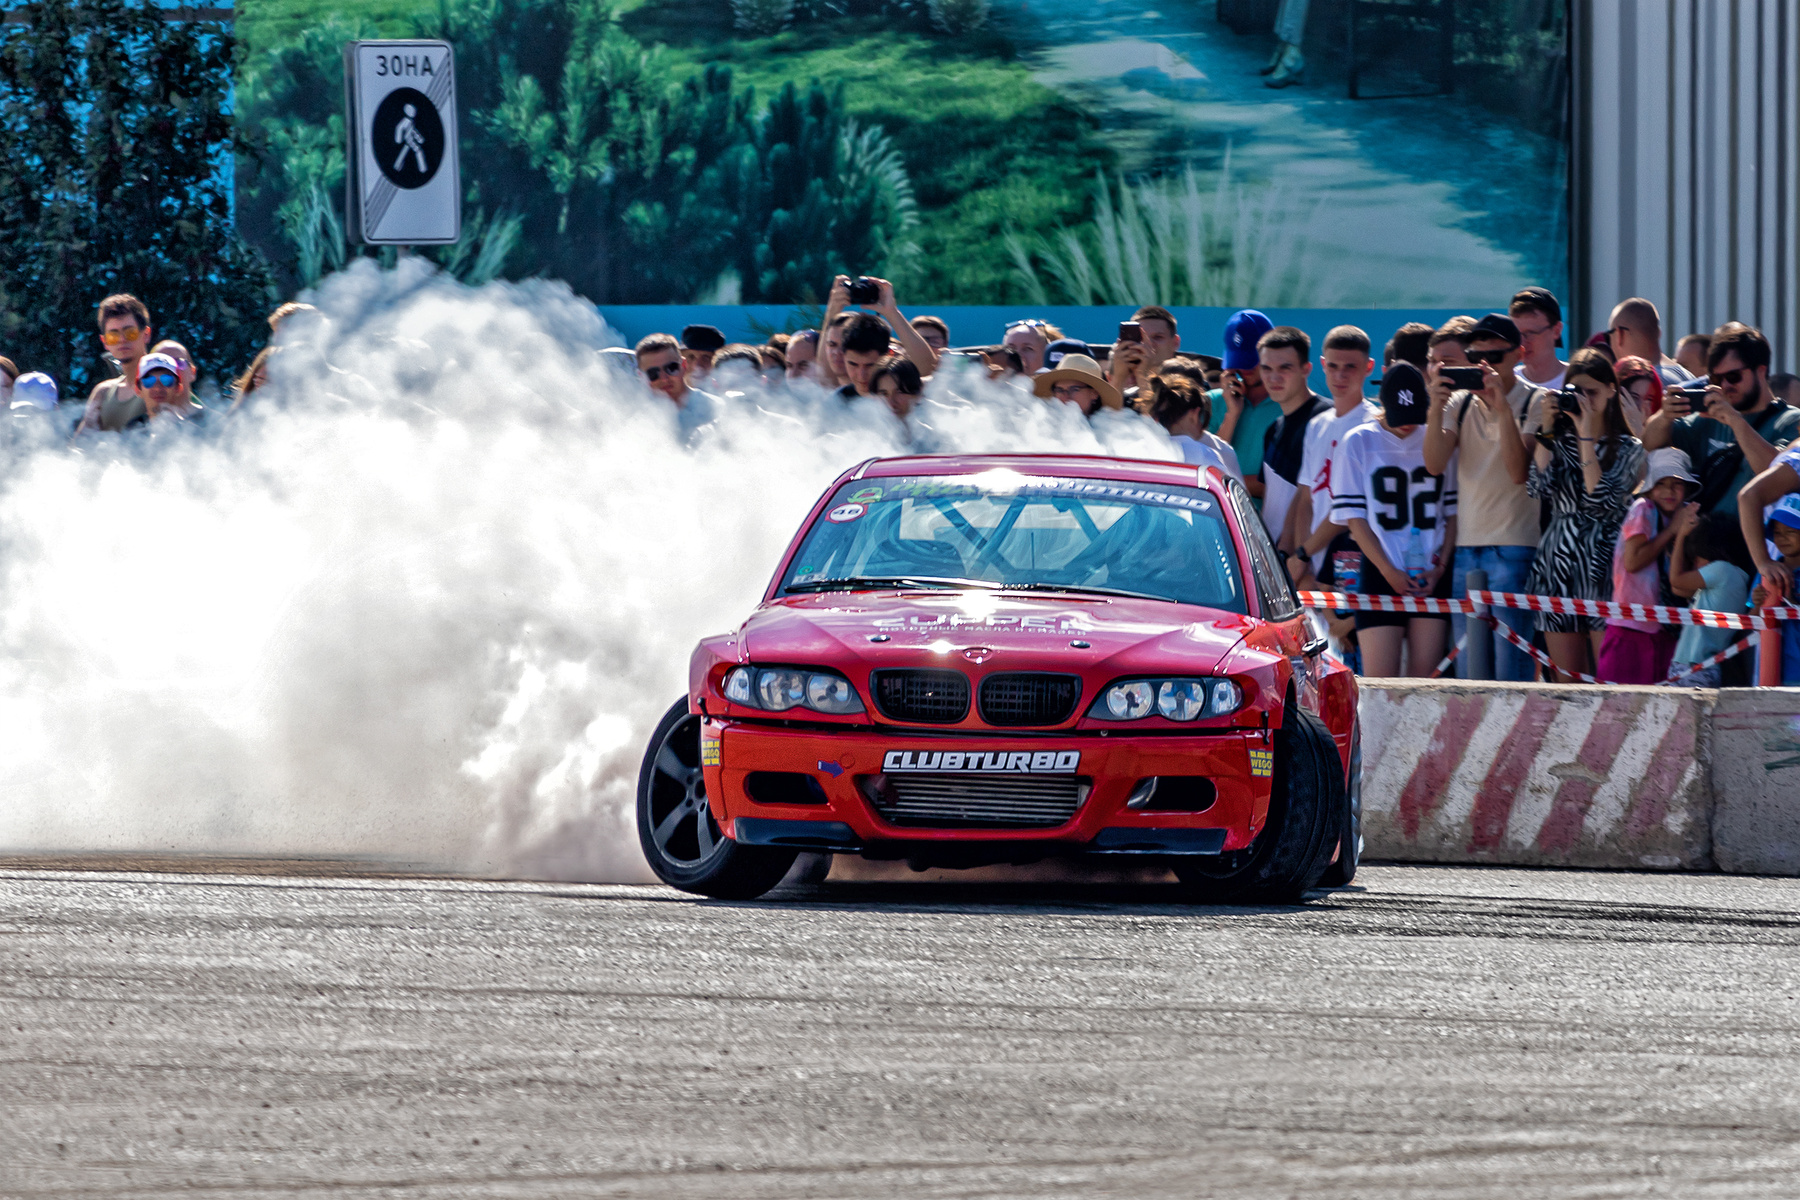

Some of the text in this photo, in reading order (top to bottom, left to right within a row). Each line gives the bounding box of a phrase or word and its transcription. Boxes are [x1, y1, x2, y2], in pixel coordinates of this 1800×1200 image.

[376, 55, 435, 76] ЗОНА
[1371, 466, 1445, 531] 92
[883, 751, 1080, 773] CLUBTURBO
[1251, 758, 1272, 769] WEGO
